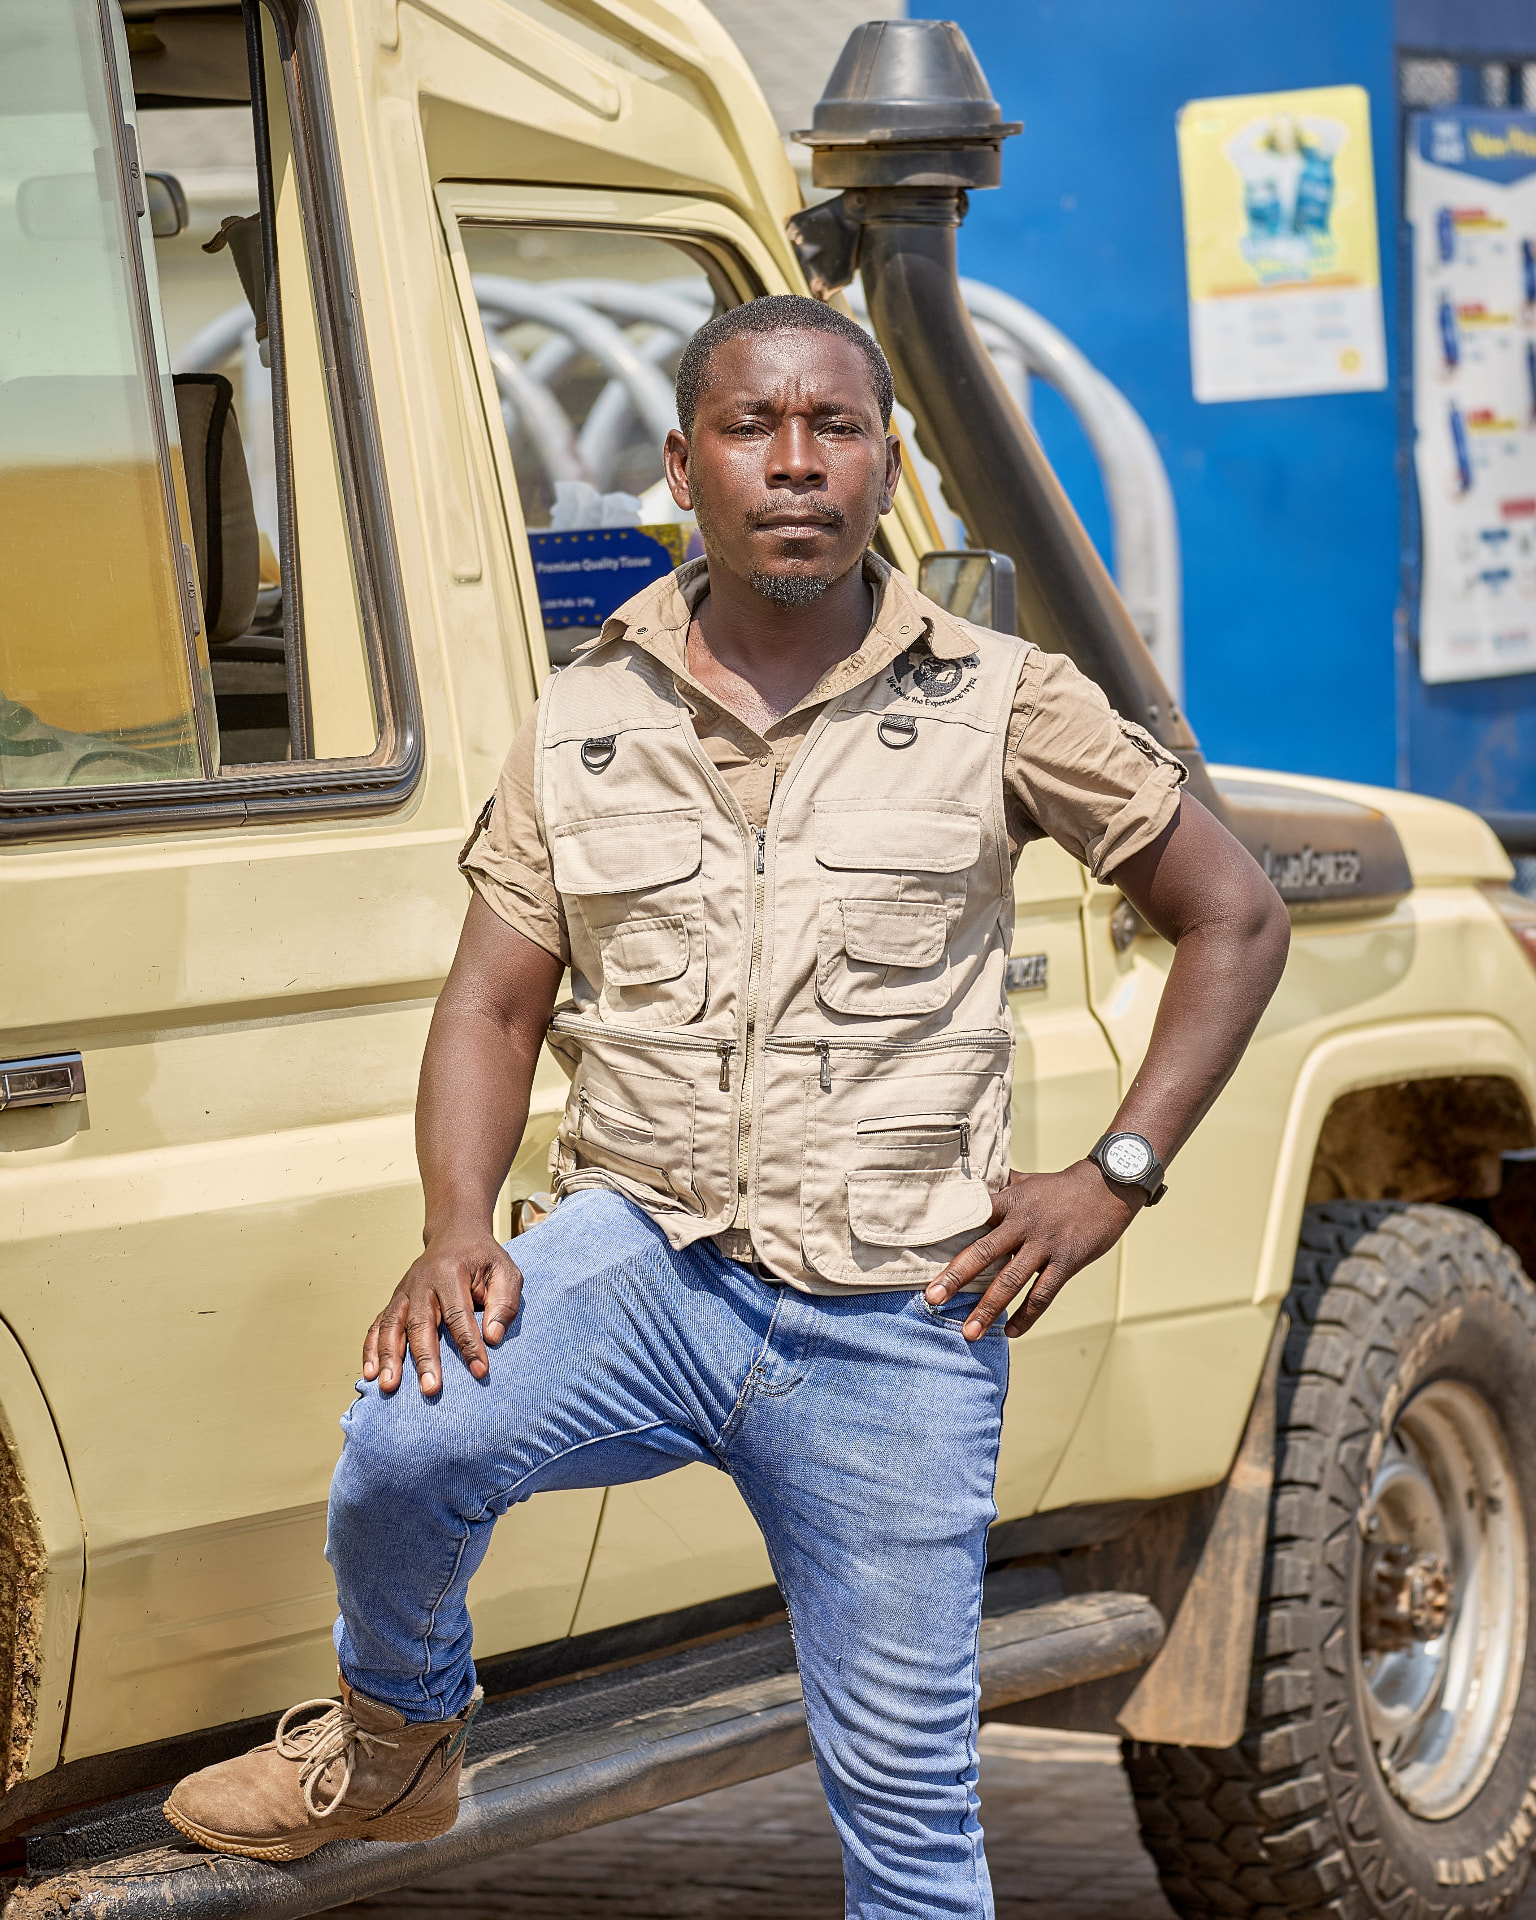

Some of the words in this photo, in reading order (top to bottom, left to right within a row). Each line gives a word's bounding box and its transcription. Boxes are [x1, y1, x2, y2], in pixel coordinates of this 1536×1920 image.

[537, 561, 580, 573] Premium
[582, 558, 618, 571] Quality
[620, 556, 651, 568] Tissue
[925, 693, 964, 708] Experience
